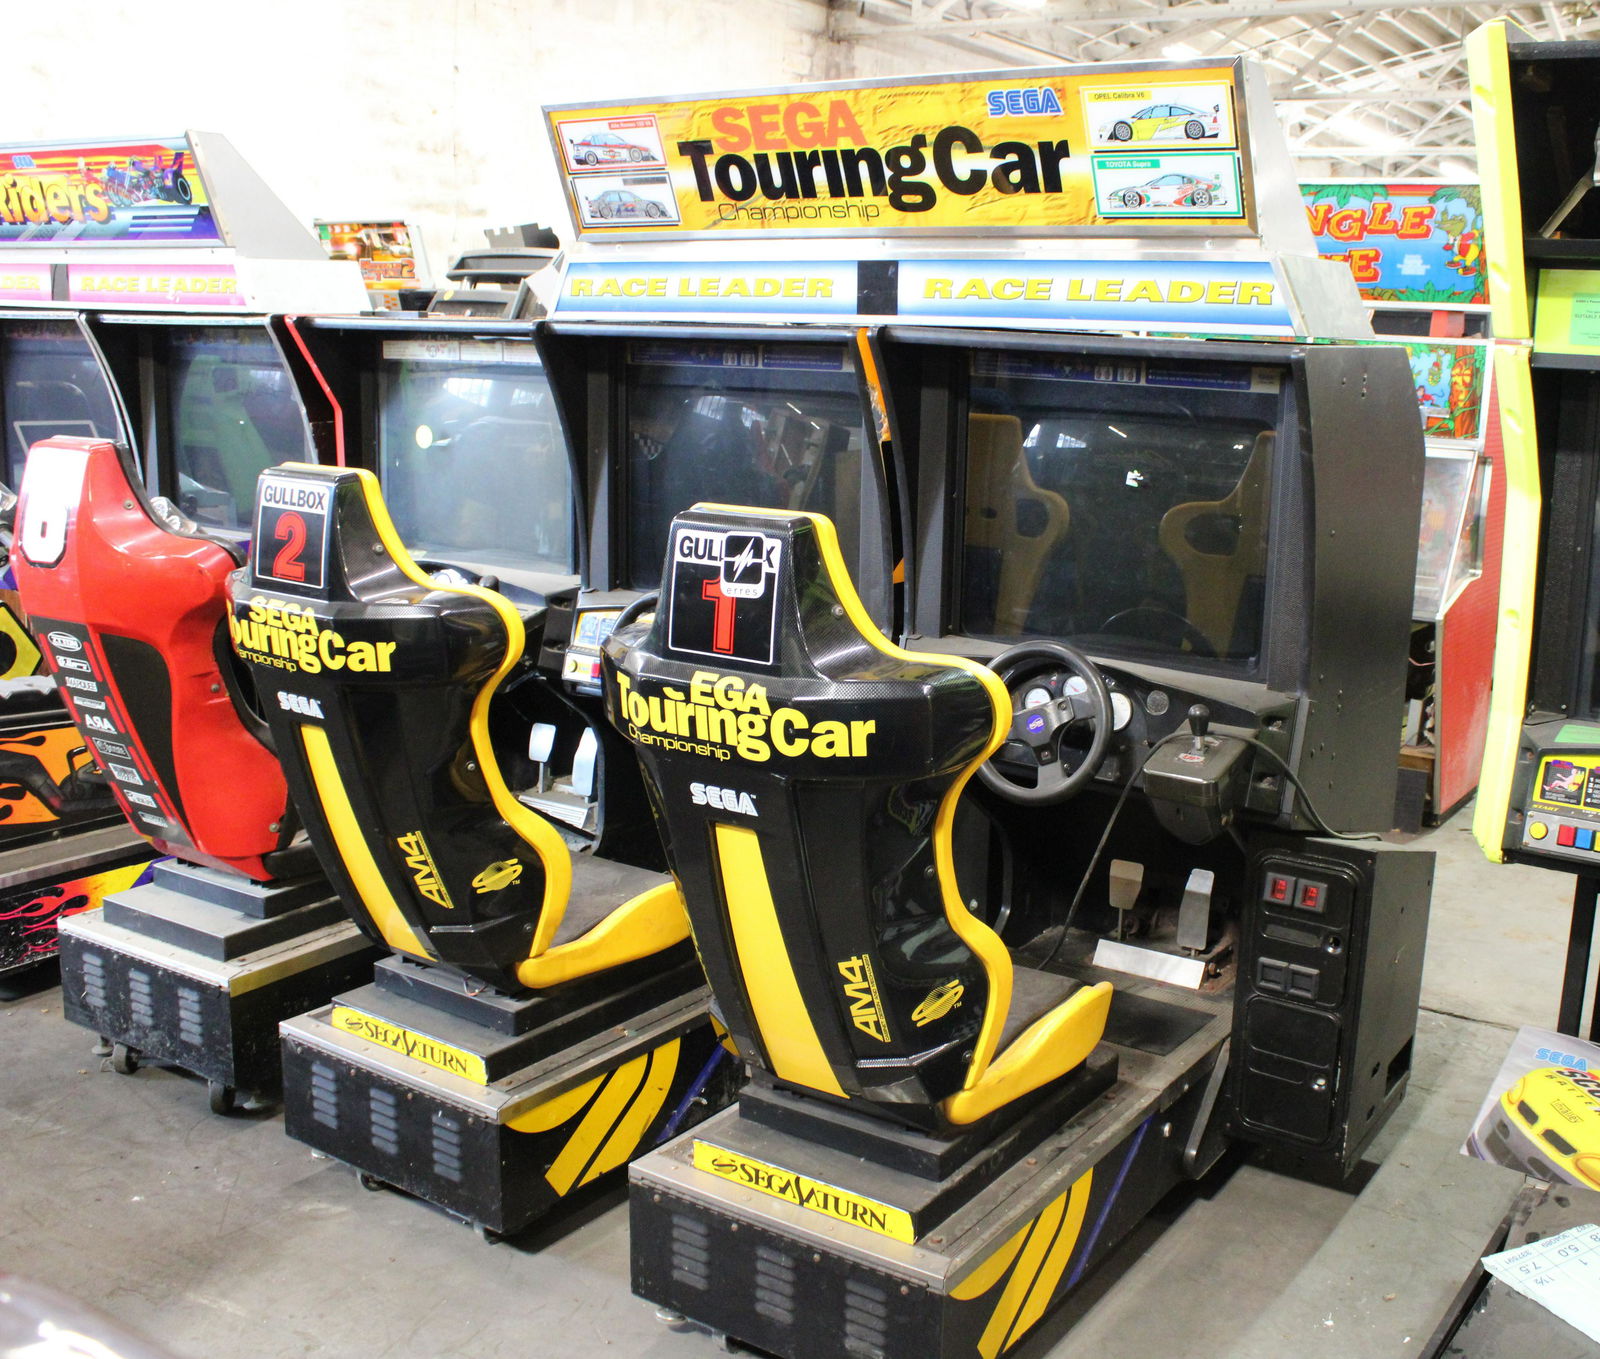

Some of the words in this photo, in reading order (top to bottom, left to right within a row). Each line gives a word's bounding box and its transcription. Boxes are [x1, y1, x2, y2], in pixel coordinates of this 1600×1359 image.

[987, 87, 1062, 116] SEGA
[712, 99, 867, 153] SEGA
[718, 200, 880, 222] Championship
[81, 276, 139, 292] RACE
[146, 277, 237, 294] LEADER
[570, 278, 668, 298] RACE
[678, 278, 833, 298] LEADER
[923, 278, 1055, 300] RACE
[1068, 279, 1274, 305] LEADER
[264, 485, 326, 511] GULLBOX
[272, 511, 307, 582] 2
[679, 535, 774, 569] GULX
[249, 595, 319, 637] SEGA
[701, 576, 737, 655] 1
[236, 648, 297, 673] ampionship
[277, 691, 324, 720] SEGA
[663, 671, 772, 716] EGA
[628, 722, 731, 762] Championship
[690, 782, 758, 818] SEGA
[1535, 1047, 1588, 1072] SEGA
